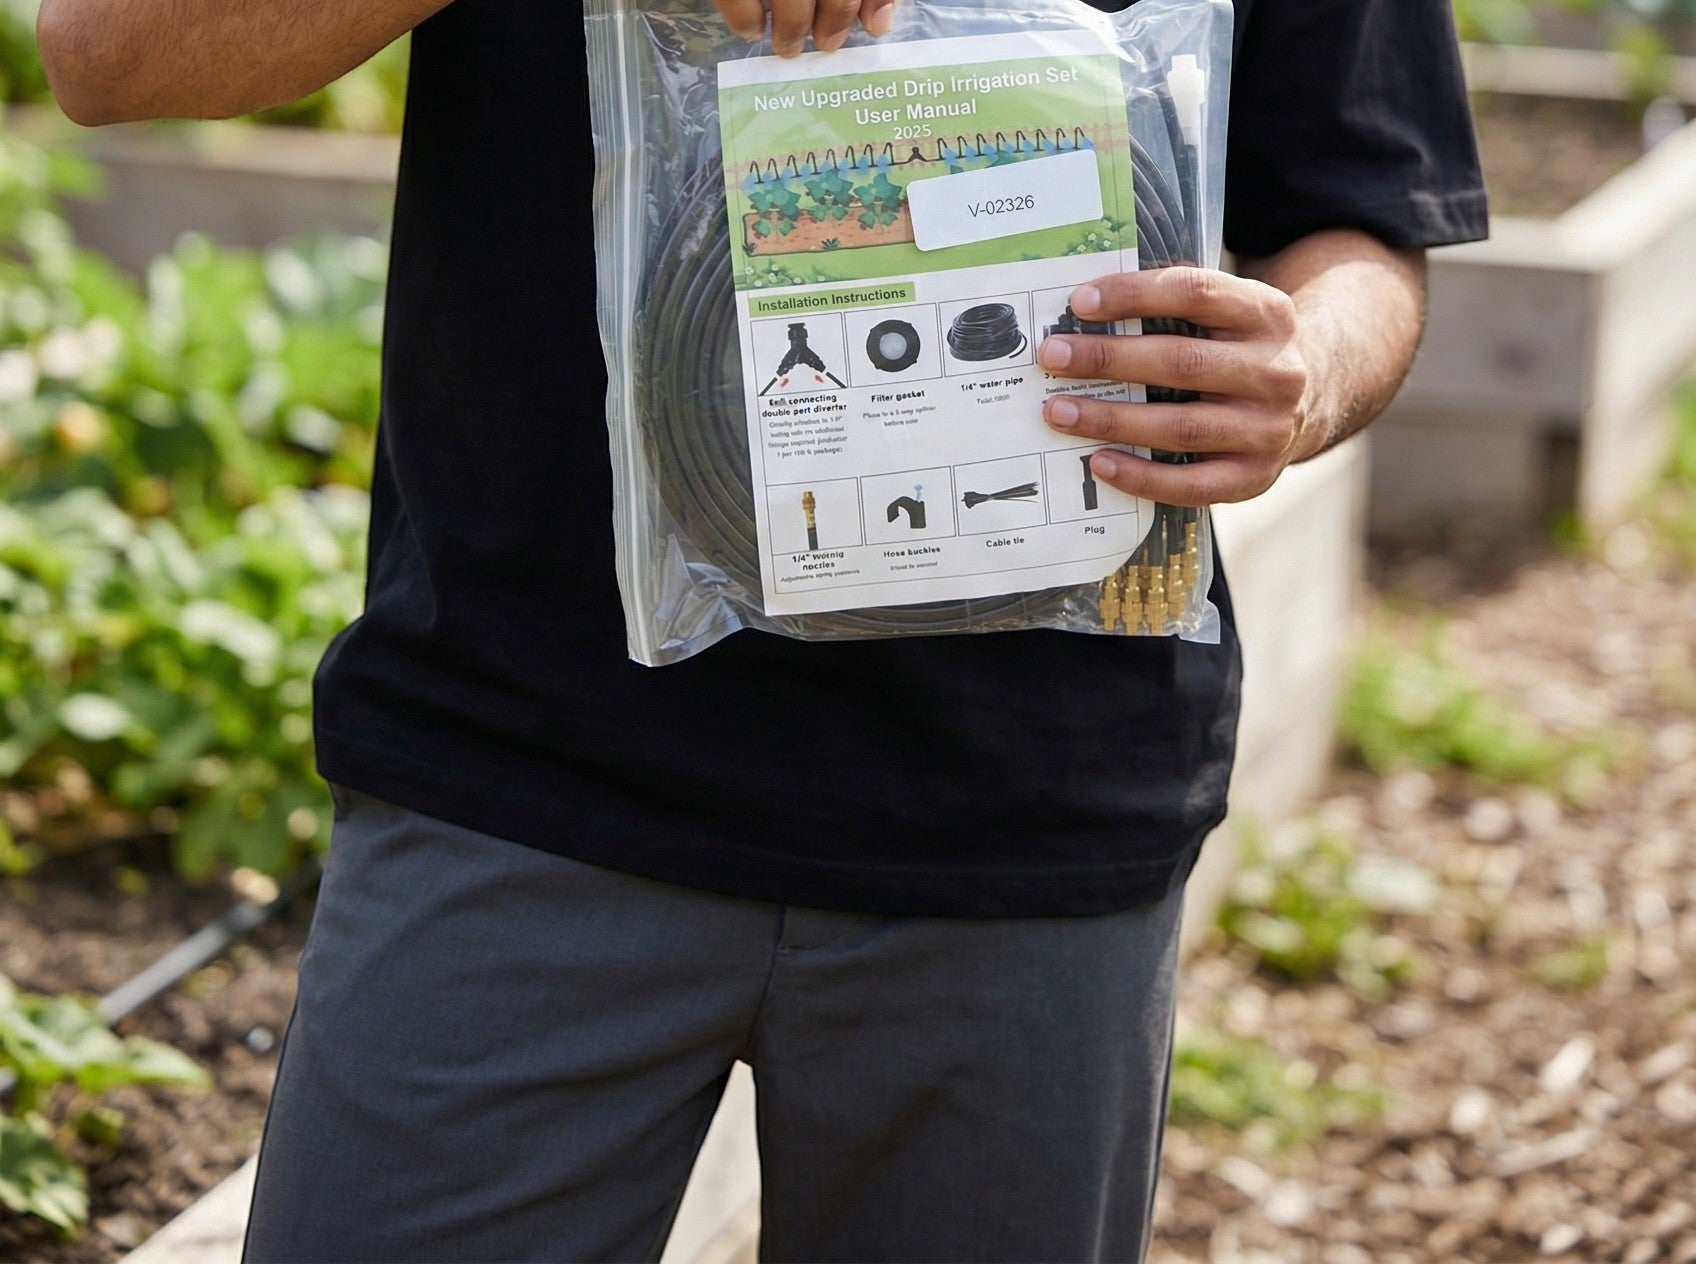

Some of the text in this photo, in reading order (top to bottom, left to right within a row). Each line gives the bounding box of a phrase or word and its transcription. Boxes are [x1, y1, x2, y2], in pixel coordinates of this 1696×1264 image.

[754, 66, 1078, 112] New Upgraded Drip Irrigation Set
[856, 98, 976, 125] User Manual
[893, 124, 931, 140] 2025
[968, 194, 1035, 218] V-02326
[758, 289, 906, 312] Installation Instructions
[1013, 536, 1025, 545] tie
[1084, 526, 1105, 535] Plug
